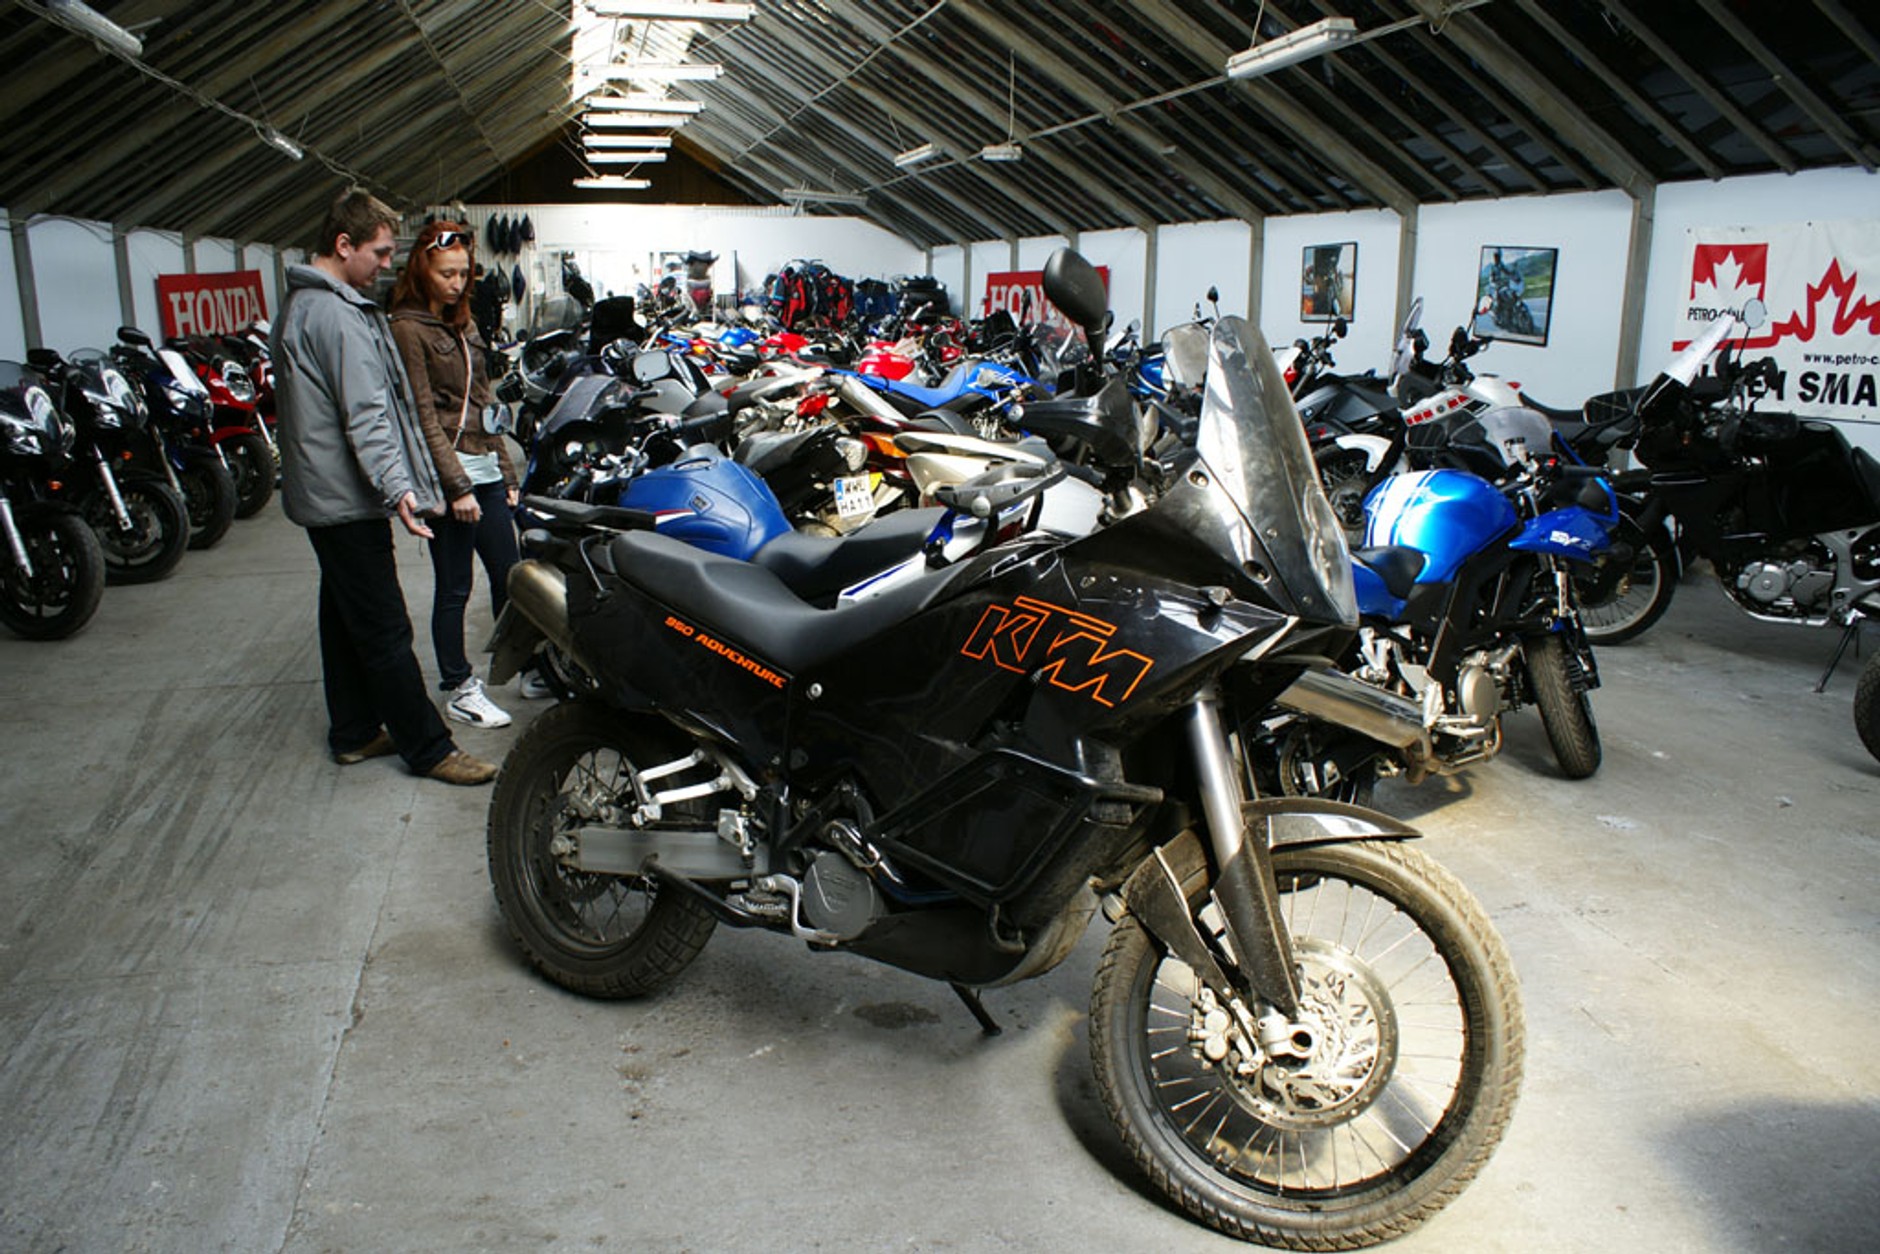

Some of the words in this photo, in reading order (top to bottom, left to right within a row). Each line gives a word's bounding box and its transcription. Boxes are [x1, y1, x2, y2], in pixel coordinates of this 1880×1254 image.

[169, 285, 264, 338] HONDA
[1798, 371, 1877, 407] SMA
[695, 633, 787, 689] ADVENTURE
[960, 595, 1155, 709] KTM
